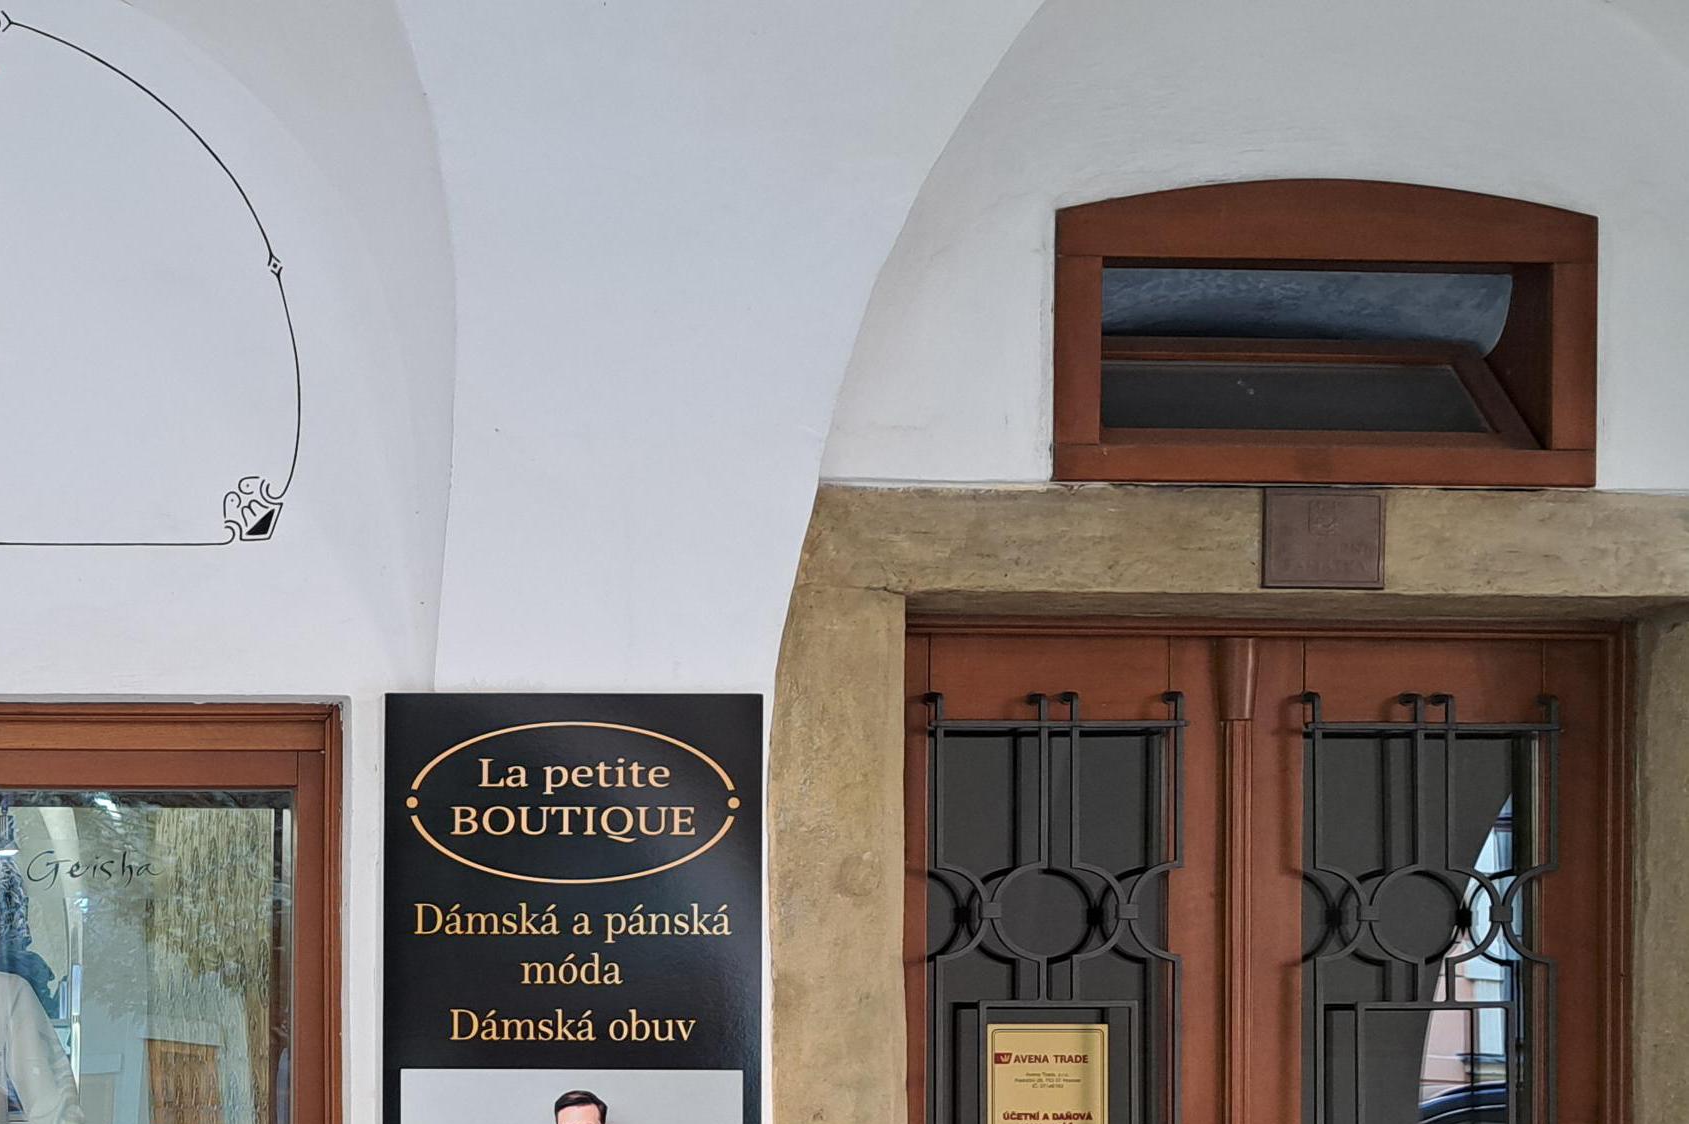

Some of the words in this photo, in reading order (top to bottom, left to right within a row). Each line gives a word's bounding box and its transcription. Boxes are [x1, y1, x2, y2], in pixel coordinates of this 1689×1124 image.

[478, 758, 528, 788] La
[543, 757, 671, 795] petite
[449, 806, 697, 843] BOUTIQUE
[413, 902, 560, 936] Dámská
[572, 912, 592, 936] a
[604, 903, 732, 944] pánská
[520, 952, 624, 985] móda
[449, 1007, 597, 1041] Dámská
[608, 1008, 697, 1041] obuv
[1013, 1054, 1050, 1064] AVENA
[1053, 1054, 1089, 1064] TRADE
[1003, 1111, 1040, 1121] ÚČETNÍ
[1043, 1112, 1050, 1121] A
